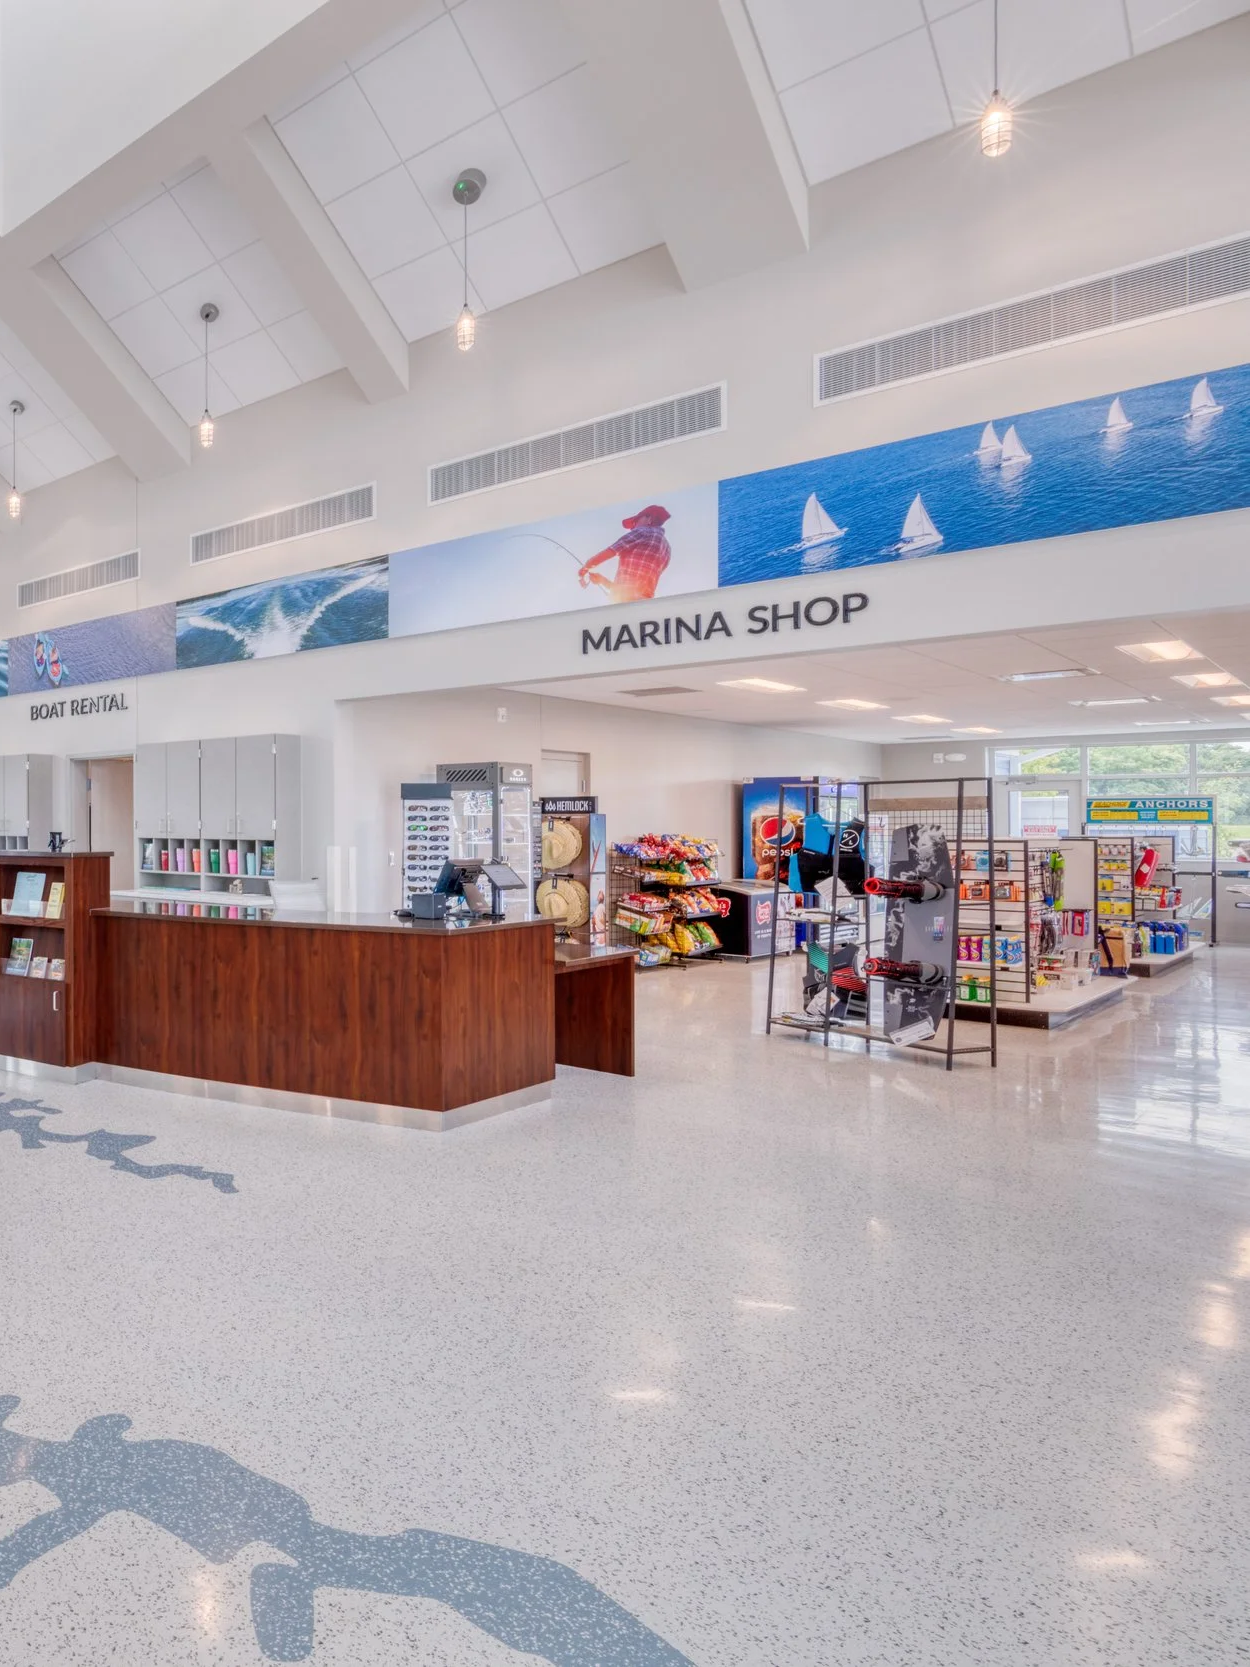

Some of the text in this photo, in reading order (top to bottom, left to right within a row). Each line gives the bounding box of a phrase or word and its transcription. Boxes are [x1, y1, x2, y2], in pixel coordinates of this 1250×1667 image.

[581, 592, 870, 655] MARINA SHOP
[30, 693, 128, 721] BOAT RENTAL
[556, 800, 589, 811] HEMLOCK
[1135, 800, 1209, 808] ANCHORS
